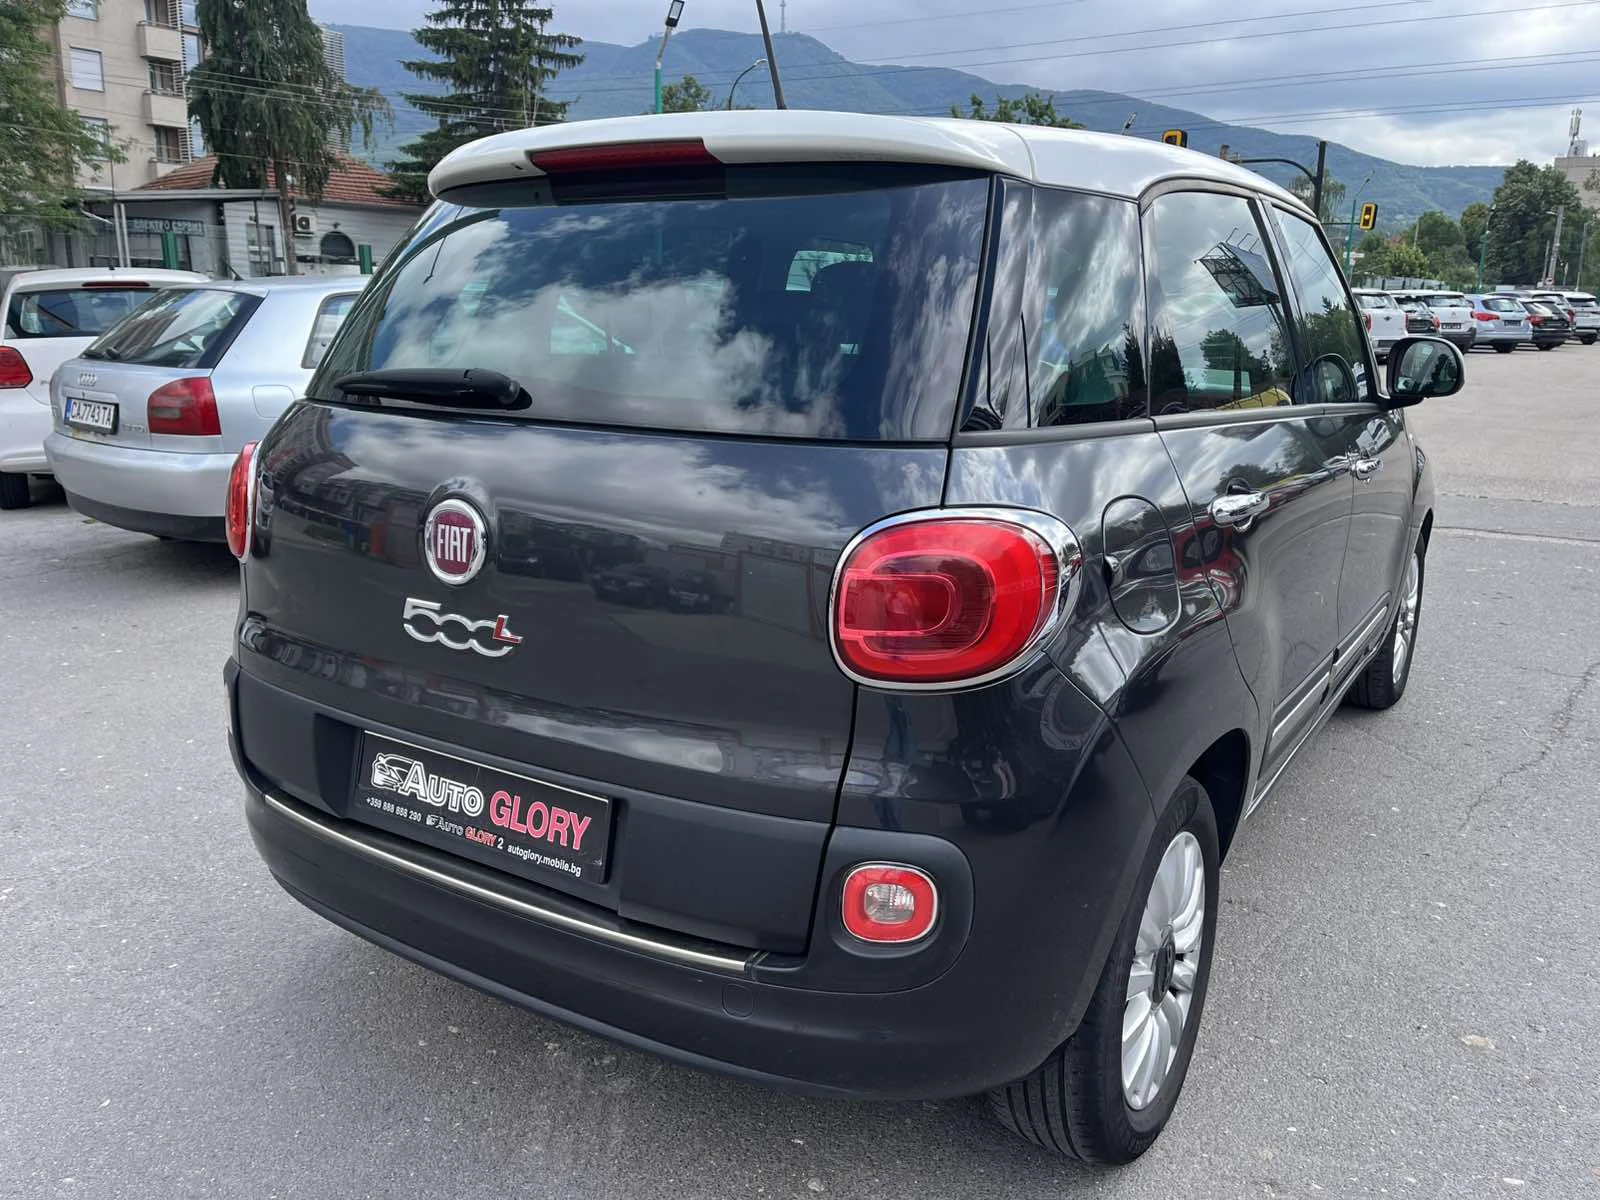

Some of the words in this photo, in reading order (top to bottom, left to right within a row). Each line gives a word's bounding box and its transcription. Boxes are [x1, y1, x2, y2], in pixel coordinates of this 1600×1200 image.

[437, 523, 471, 563] FIAT
[403, 597, 524, 658] 500L
[366, 797, 382, 809] +359
[382, 801, 395, 813] 888
[408, 810, 422, 822] 290
[398, 761, 484, 817] AUTO
[490, 790, 592, 851] GLORY
[464, 825, 497, 847] GLORY
[497, 837, 504, 850] 2
[507, 844, 582, 878] autoglory.mobile.bg
